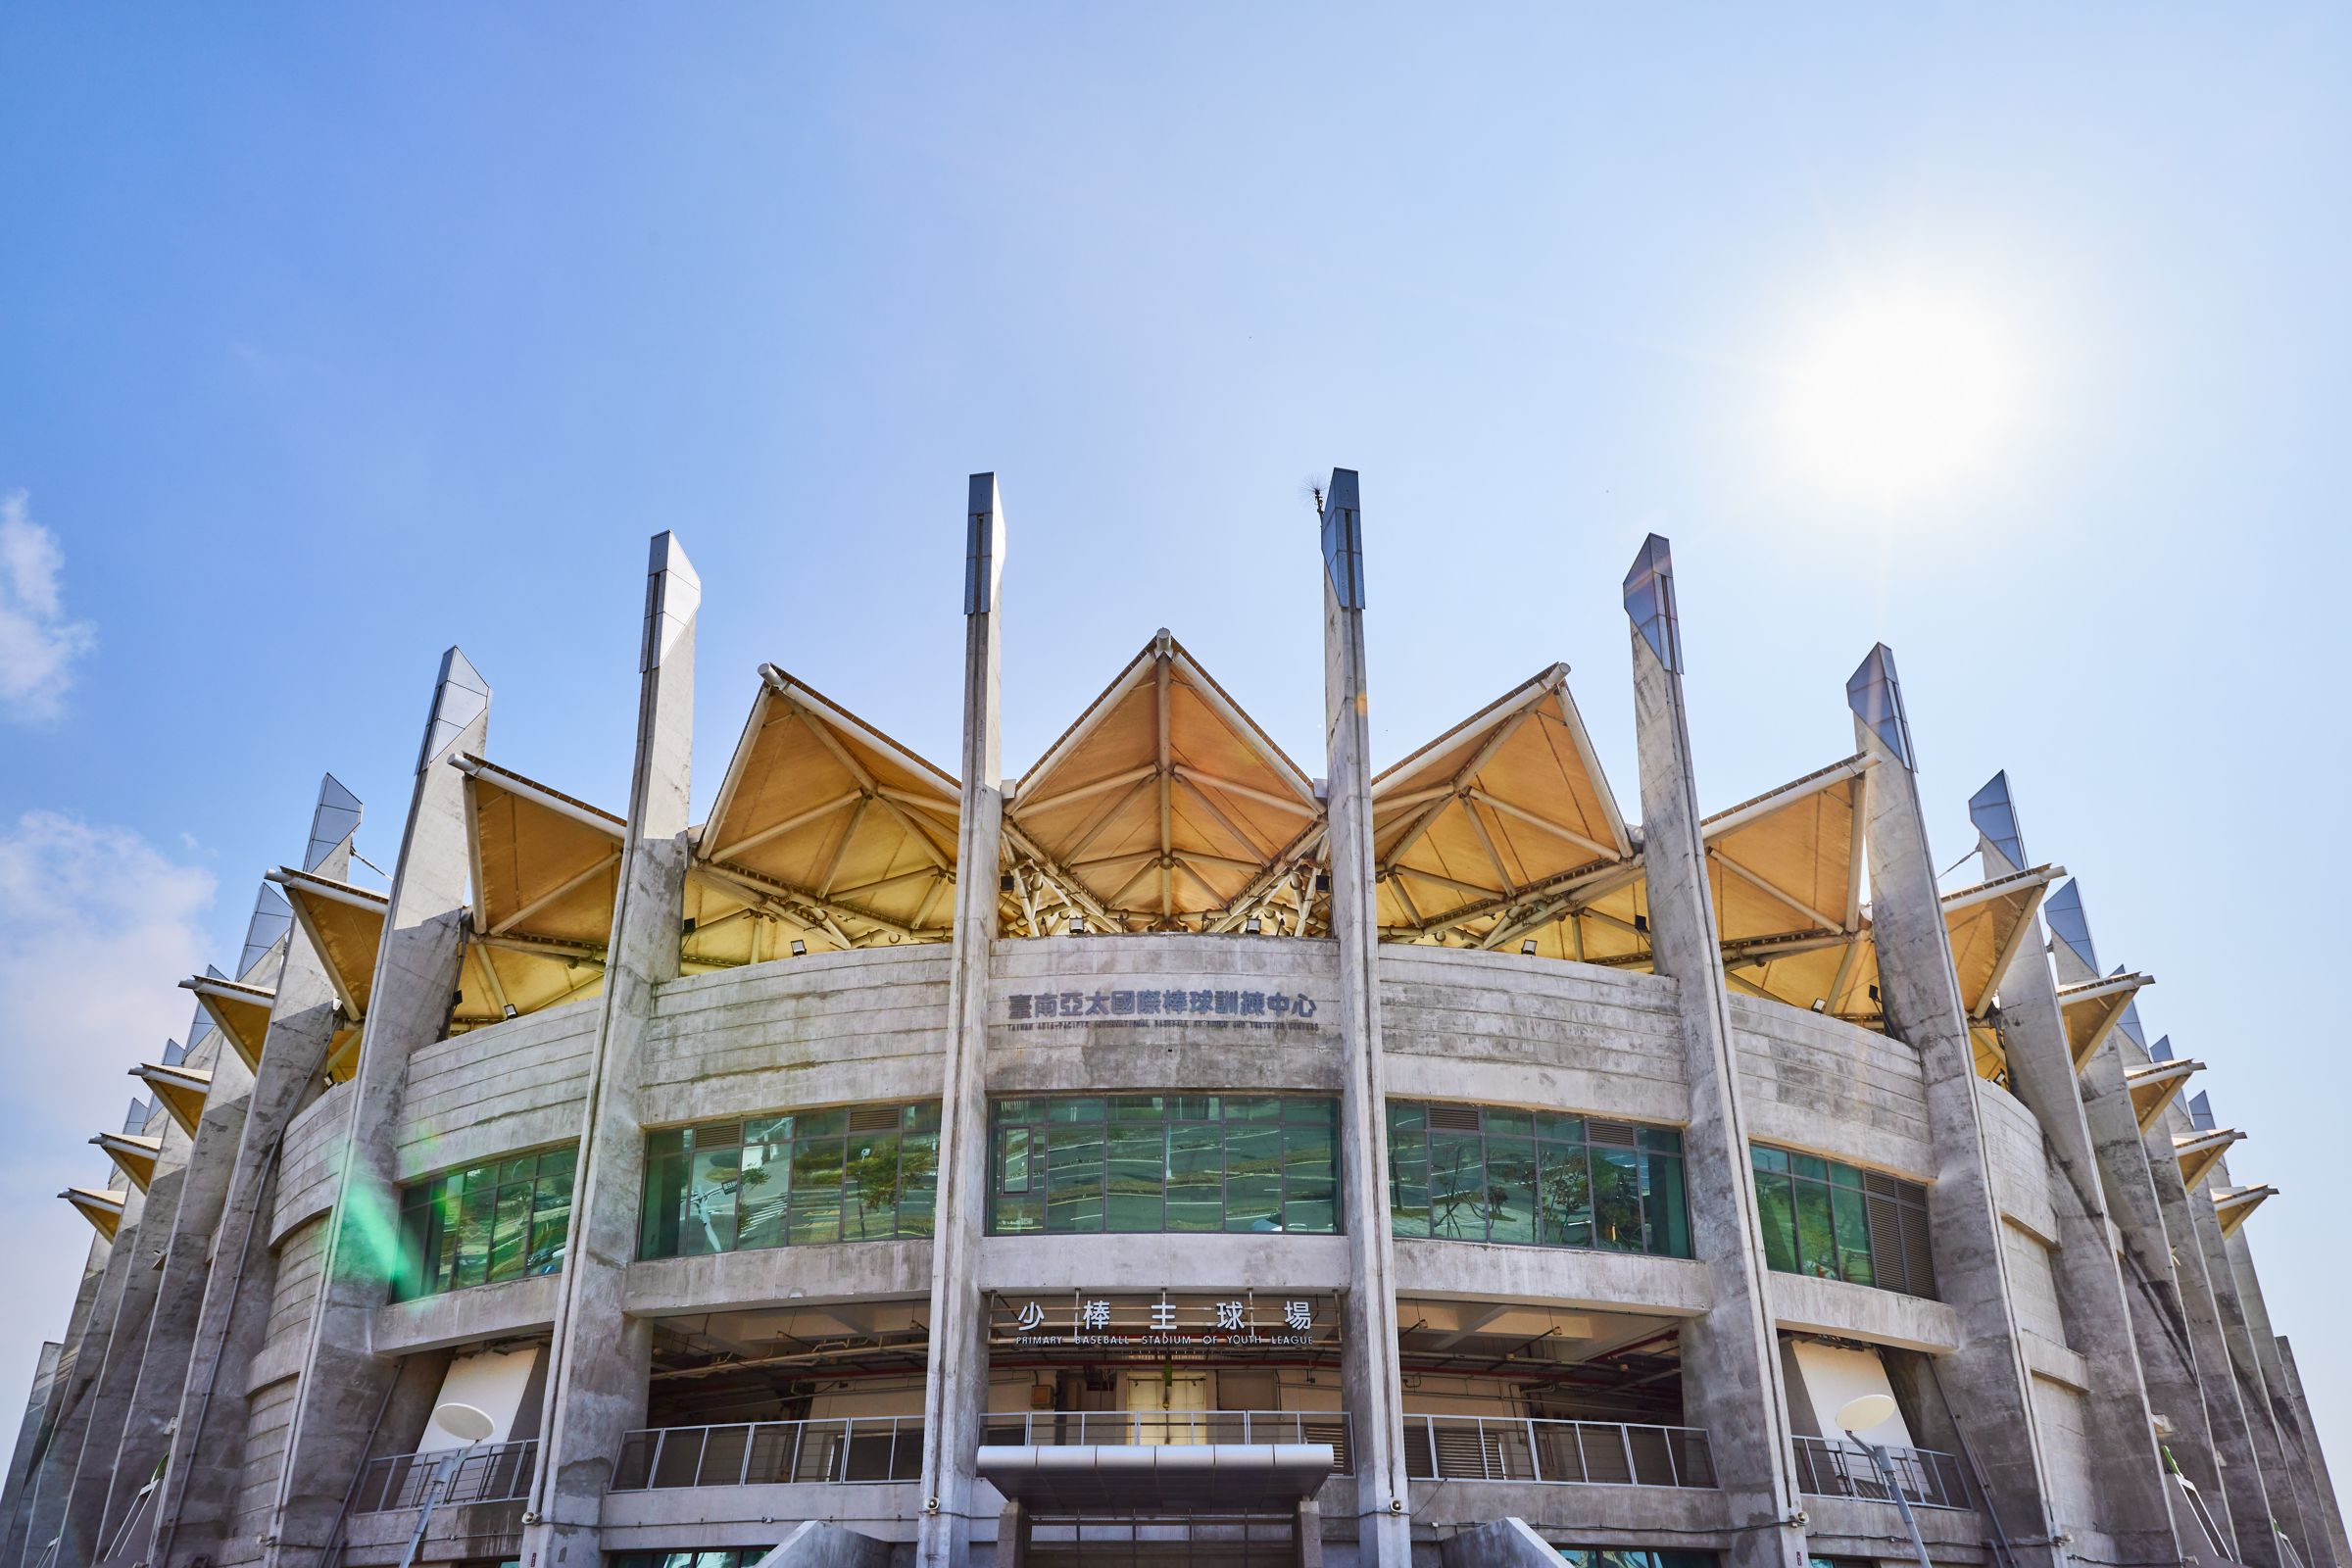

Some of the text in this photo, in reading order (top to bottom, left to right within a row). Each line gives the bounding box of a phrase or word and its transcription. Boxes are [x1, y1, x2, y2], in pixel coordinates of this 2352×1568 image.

[1017, 1299, 1311, 1331] 少棒主球場
[1015, 1336, 1313, 1345] PRIMARY BASEBALL STADIUM OF YOUTH LEAGUE
